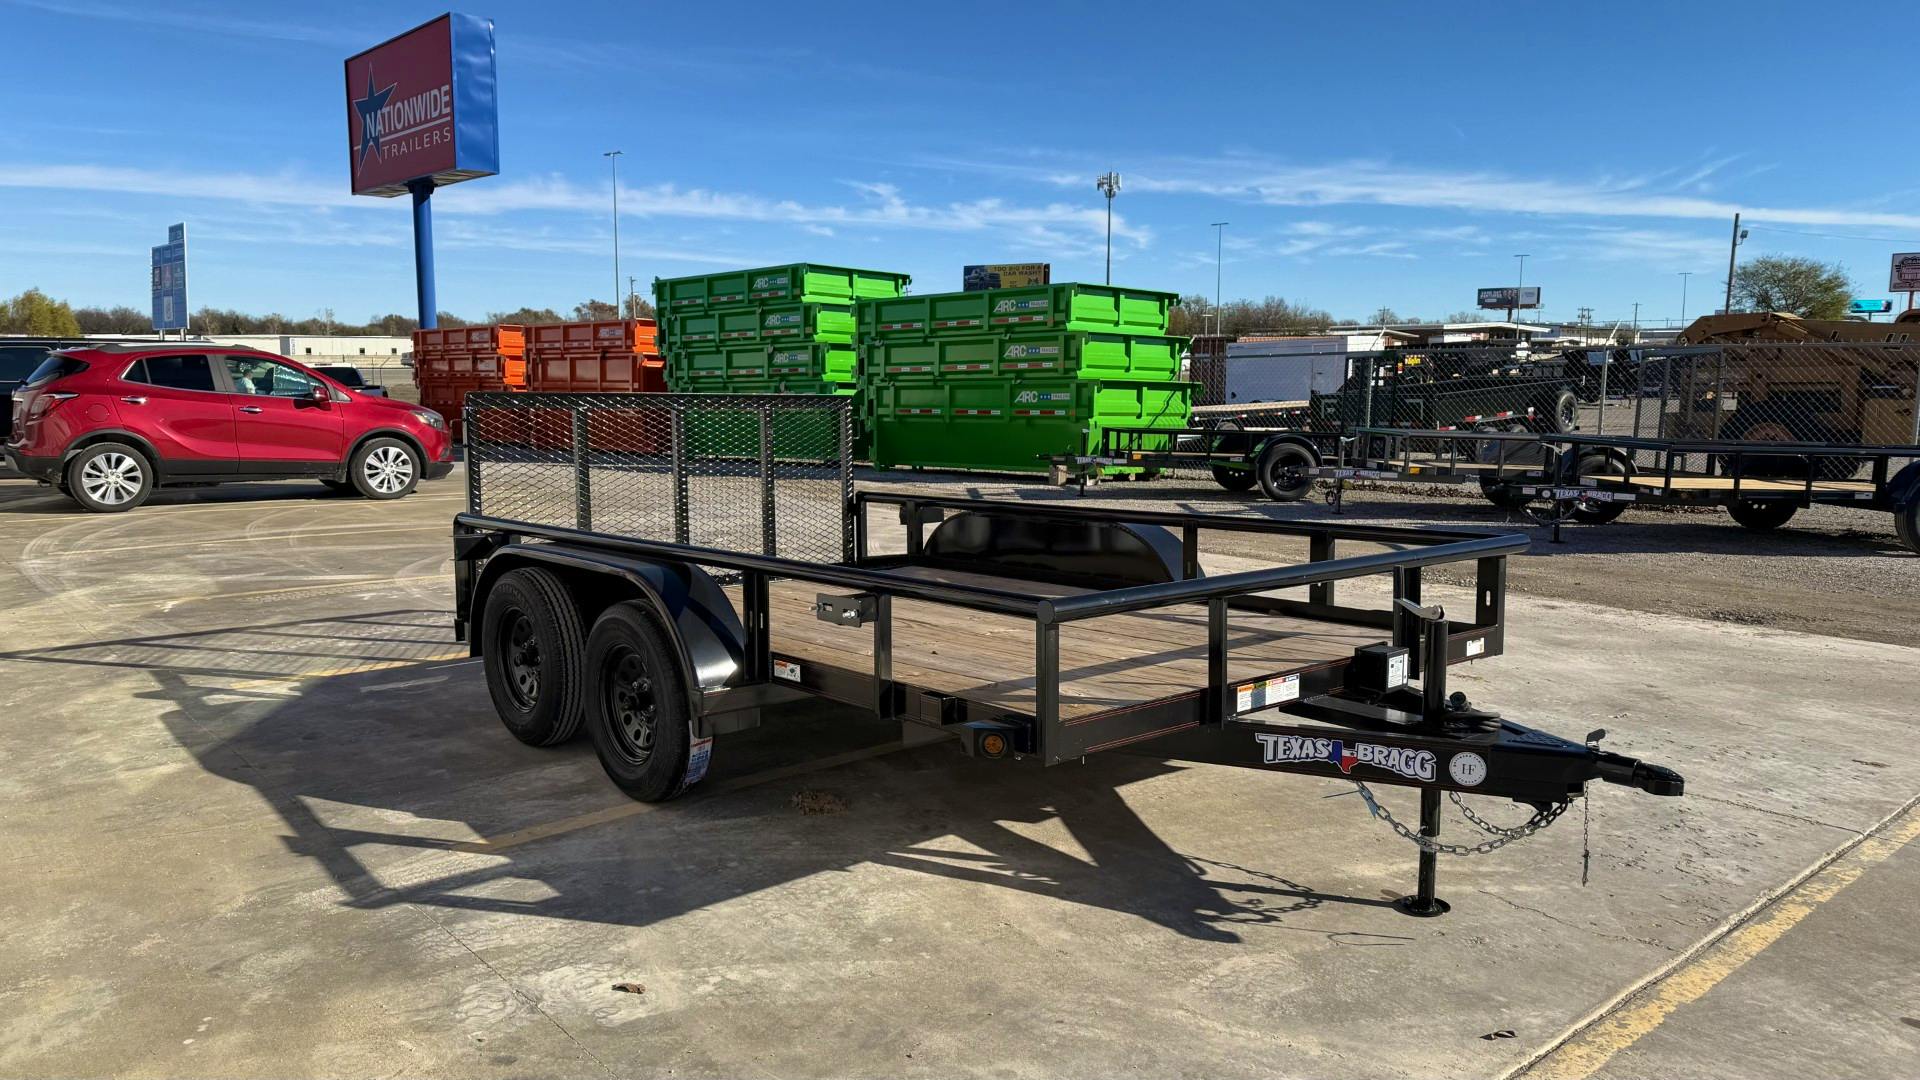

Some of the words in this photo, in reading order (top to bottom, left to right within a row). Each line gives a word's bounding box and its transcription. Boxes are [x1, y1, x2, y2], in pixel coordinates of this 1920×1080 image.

[366, 85, 450, 138] NATIONWIDE
[383, 127, 451, 160] TRAILERS
[993, 299, 1016, 312] ARC
[1003, 345, 1027, 357] ARC
[1014, 391, 1038, 403] ARC
[1256, 734, 1332, 763] TEXAS
[1355, 743, 1437, 782] BRAGG
